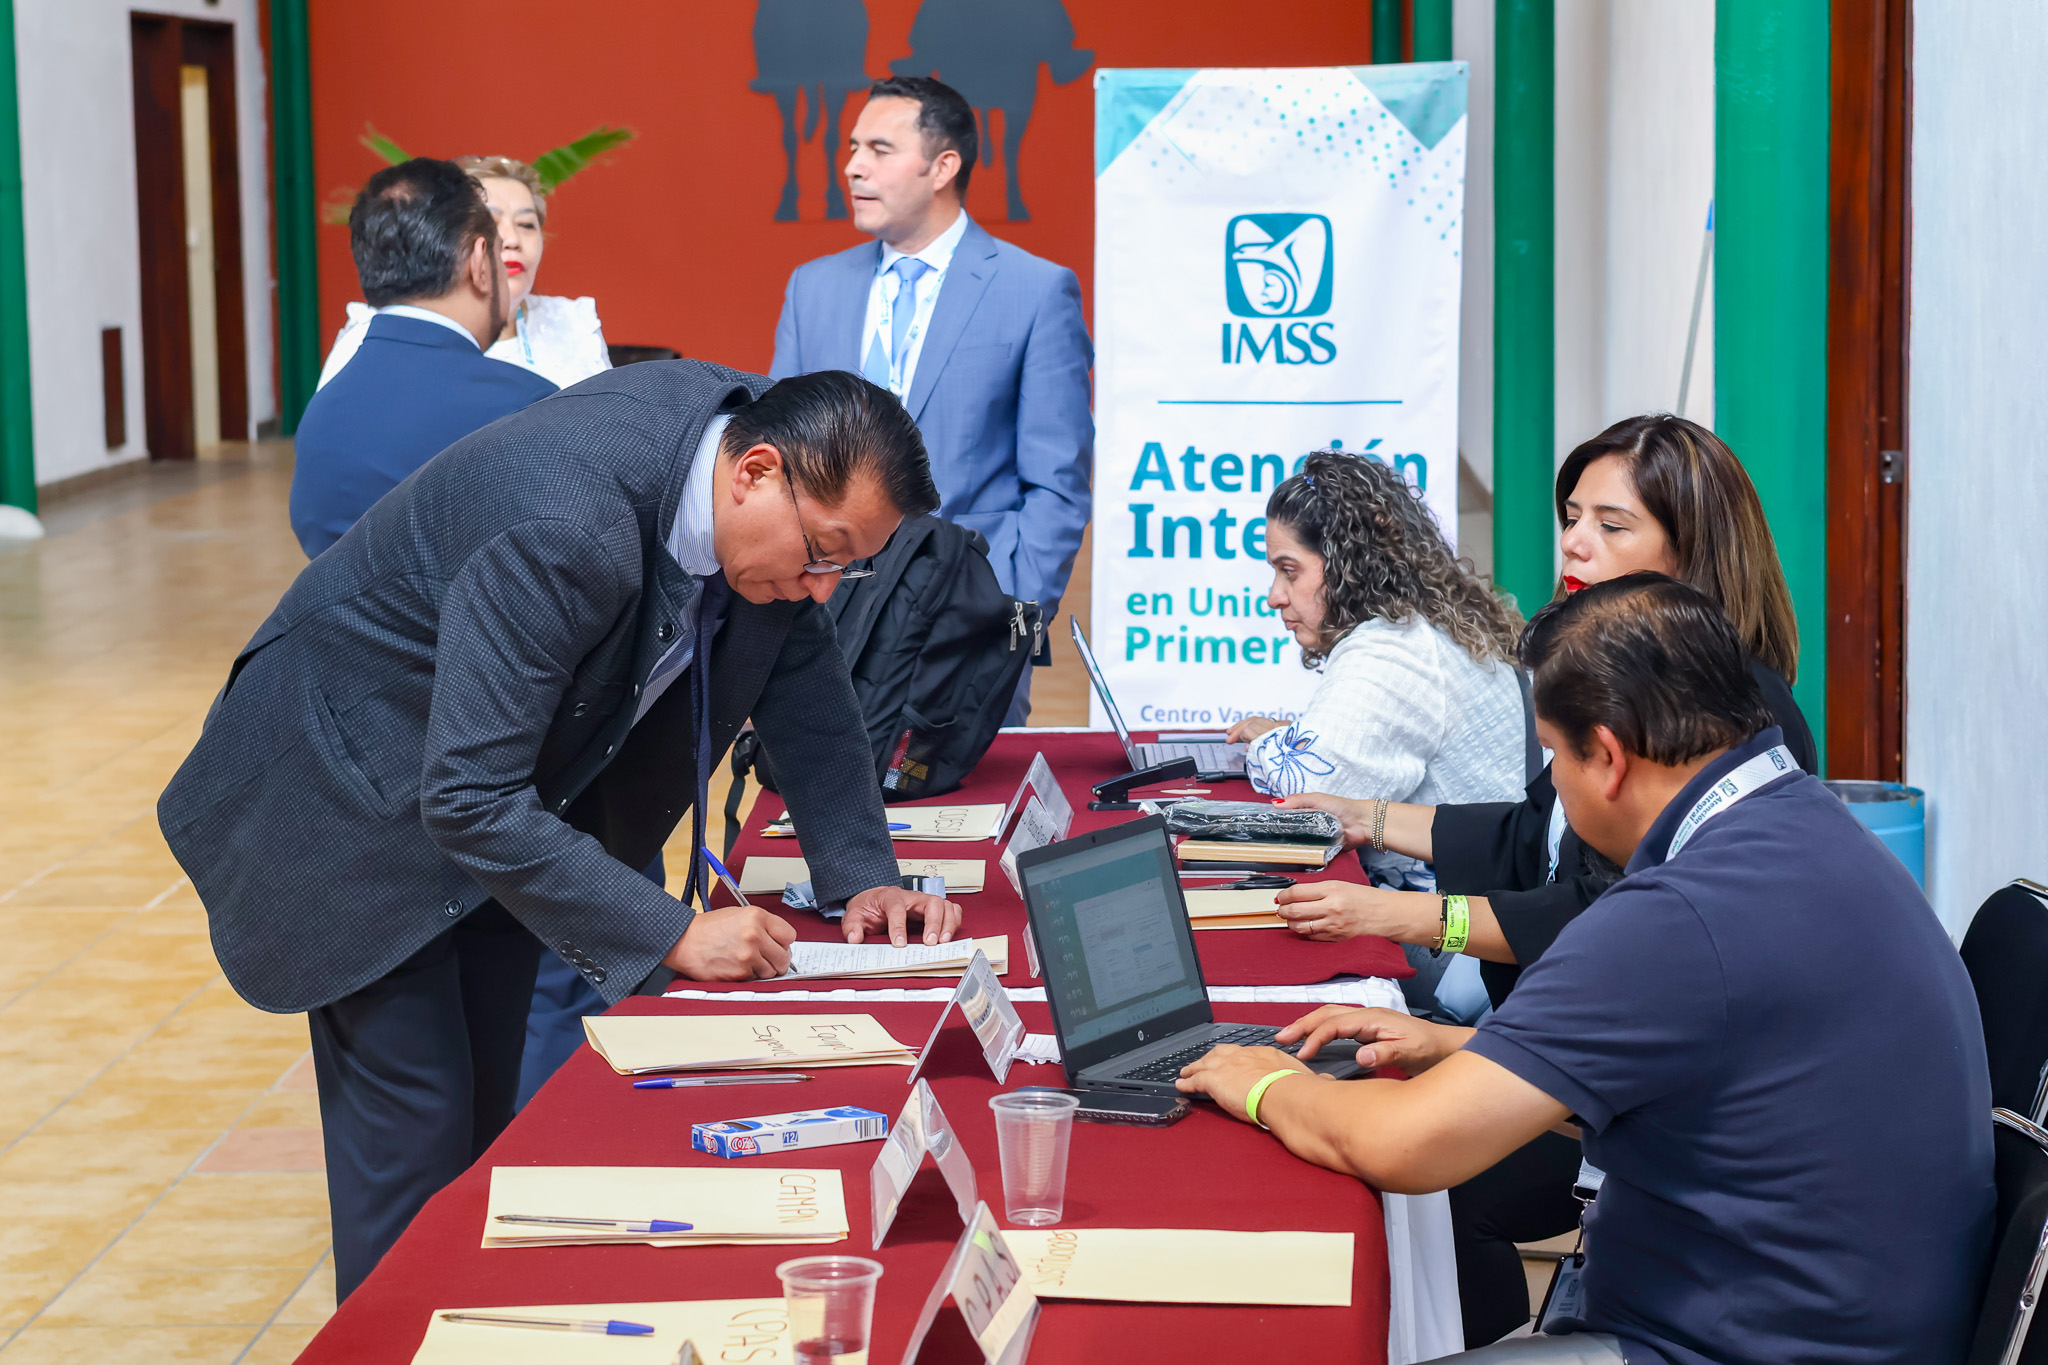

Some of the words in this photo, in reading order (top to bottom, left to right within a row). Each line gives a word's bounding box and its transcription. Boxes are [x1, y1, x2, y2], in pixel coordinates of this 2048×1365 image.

[1221, 321, 1337, 365] IMSS
[1129, 438, 1428, 493] Atenn
[1126, 592, 1173, 616] en
[1126, 625, 1291, 665] Primer
[1140, 705, 1212, 723] Centro
[1689, 790, 1719, 822] Integral
[1694, 796, 1723, 825] Atención
